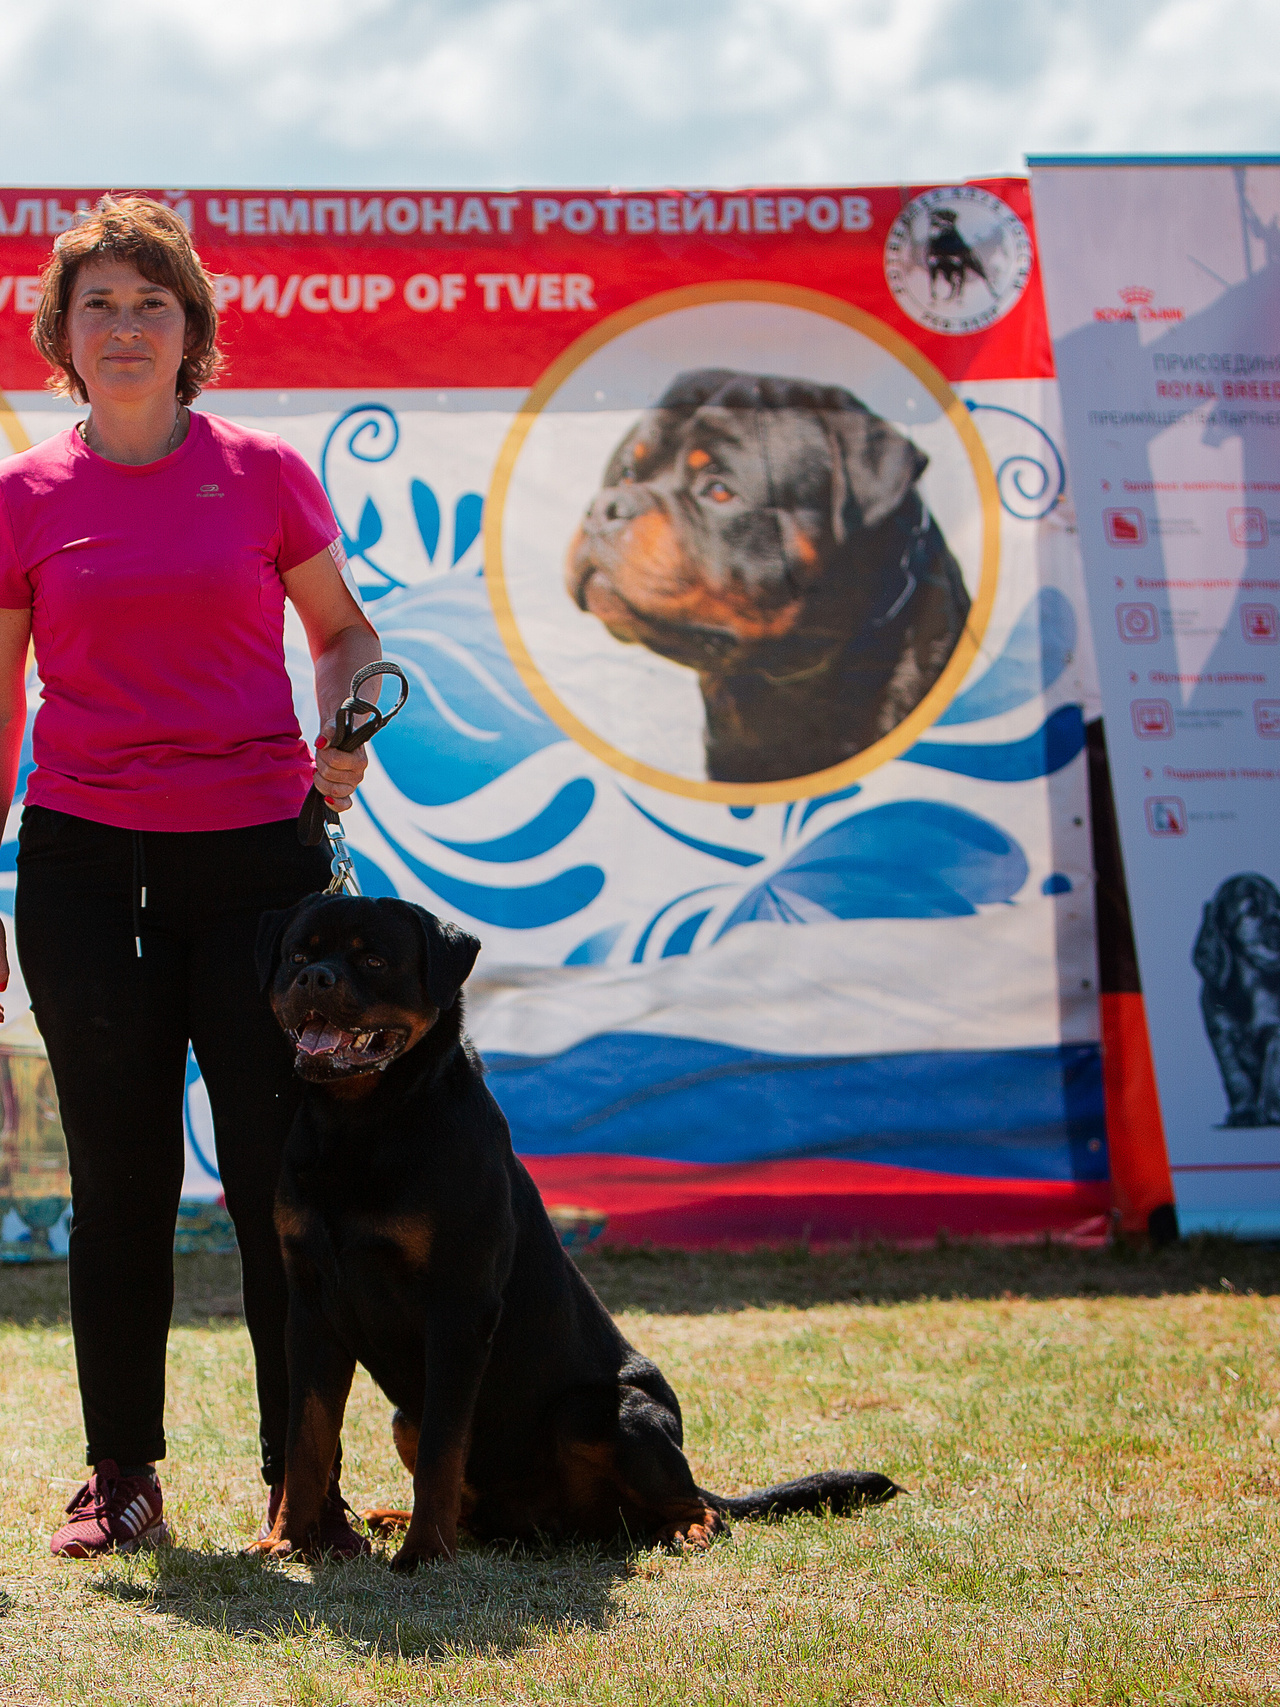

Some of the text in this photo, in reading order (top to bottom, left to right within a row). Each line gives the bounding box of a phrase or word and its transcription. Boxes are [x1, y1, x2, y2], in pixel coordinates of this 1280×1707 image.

[207, 196, 521, 236] ЧЕМПИОНАТ
[533, 190, 873, 234] РОТВЕЙЛЕРОВ
[213, 273, 395, 317] РИ/CUP
[403, 272, 467, 313] OF
[474, 272, 598, 313] TVER
[1156, 379, 1216, 400] ROYAL
